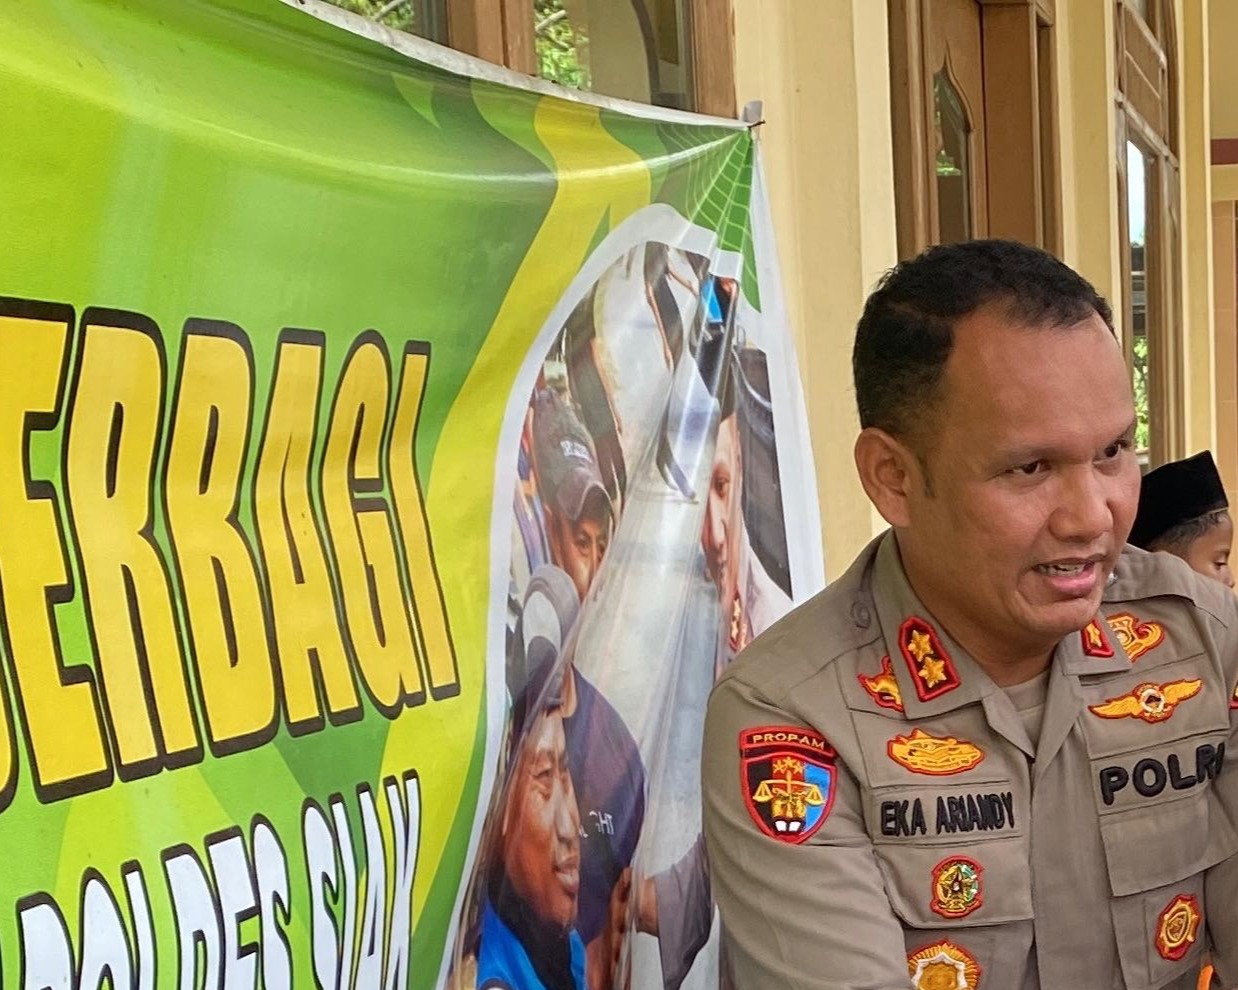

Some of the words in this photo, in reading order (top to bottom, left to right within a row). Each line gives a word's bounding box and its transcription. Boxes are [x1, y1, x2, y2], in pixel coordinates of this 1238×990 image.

[0, 295, 460, 815] ERBAGI
[752, 733, 825, 750] PROPAM
[881, 798, 927, 836] EKA
[936, 792, 1015, 834] ARIANDY
